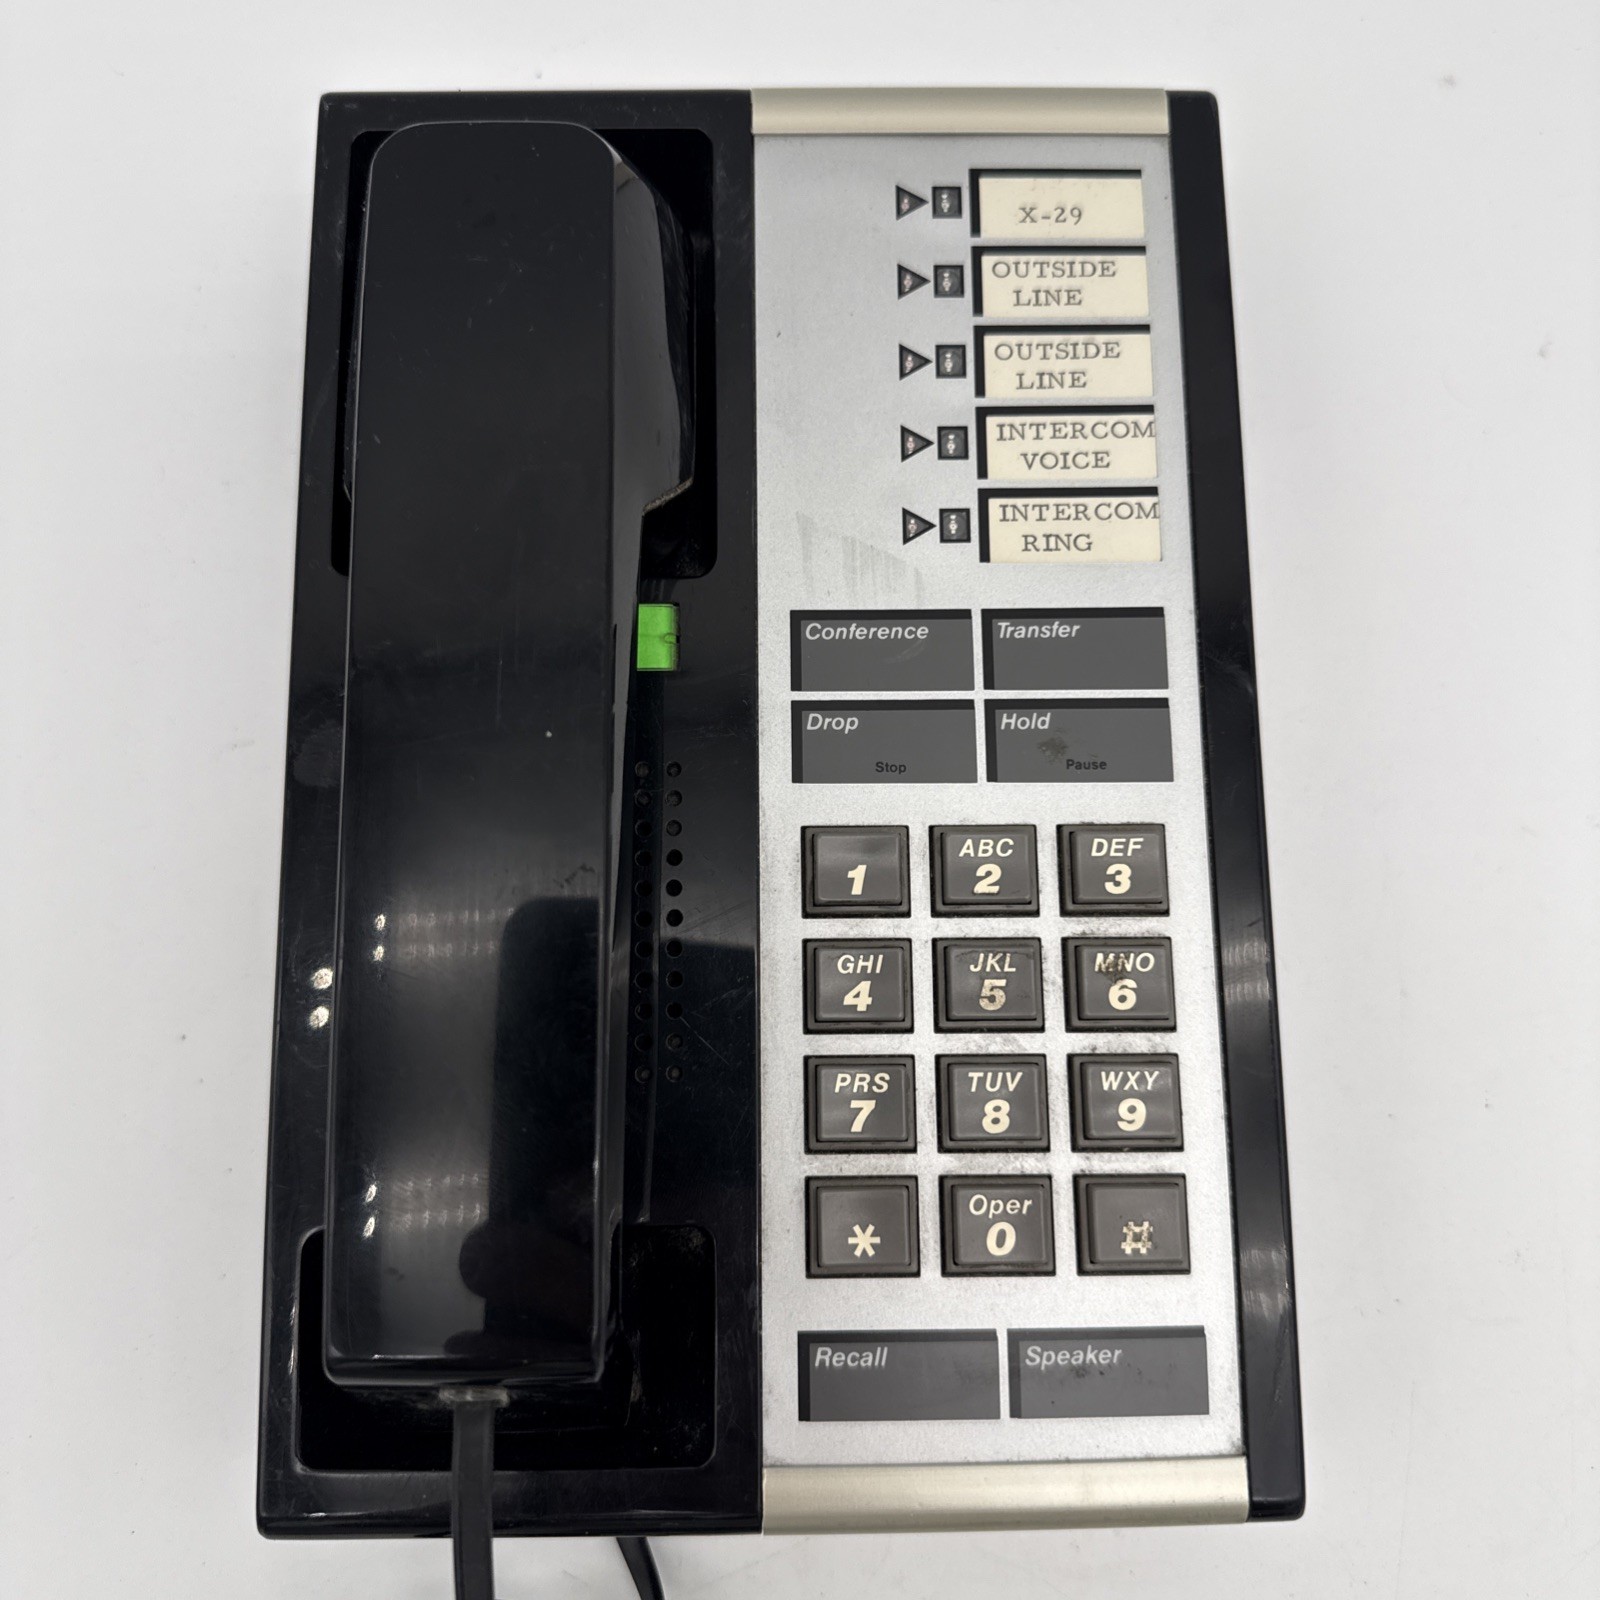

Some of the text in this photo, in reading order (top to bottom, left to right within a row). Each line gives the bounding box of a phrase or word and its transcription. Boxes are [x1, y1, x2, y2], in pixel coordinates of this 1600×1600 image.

[1018, 207, 1083, 225] X-29
[991, 260, 1117, 279] OUTSIDE
[1012, 289, 1083, 307] LINE
[994, 342, 1121, 360] OUTSIDE
[1016, 371, 1088, 390] LINE
[996, 421, 1156, 441] INTERCOM
[1020, 451, 1110, 470] VOICE
[999, 502, 1160, 522] INTERCOM
[1021, 534, 1093, 552] RING
[804, 622, 929, 641] Conference
[997, 621, 1080, 639] Transfer
[806, 712, 859, 734] Drop
[1000, 711, 1051, 730] Hold
[875, 761, 907, 774] Stop
[1065, 759, 1107, 771] Pause
[958, 837, 1014, 858] ABC
[1091, 837, 1144, 857] DEF
[846, 864, 867, 896] 1
[973, 863, 1002, 895] 2
[1104, 863, 1132, 894] 3
[836, 954, 884, 974] GHI
[969, 952, 1017, 973] JKL
[1094, 952, 1156, 973] MNO
[842, 980, 873, 1012] 4
[978, 979, 1007, 1011] 5
[1108, 978, 1138, 1011] 6
[834, 1072, 891, 1093] PRS
[967, 1071, 1023, 1092] TUV
[1100, 1070, 1160, 1091] WXY
[849, 1099, 877, 1133] 7
[981, 1099, 1010, 1134] 8
[1117, 1098, 1147, 1131] 9
[968, 1194, 1033, 1219] Oper
[985, 1221, 1016, 1256] 0
[814, 1346, 888, 1367] Recall
[1025, 1344, 1122, 1371] Speaker
